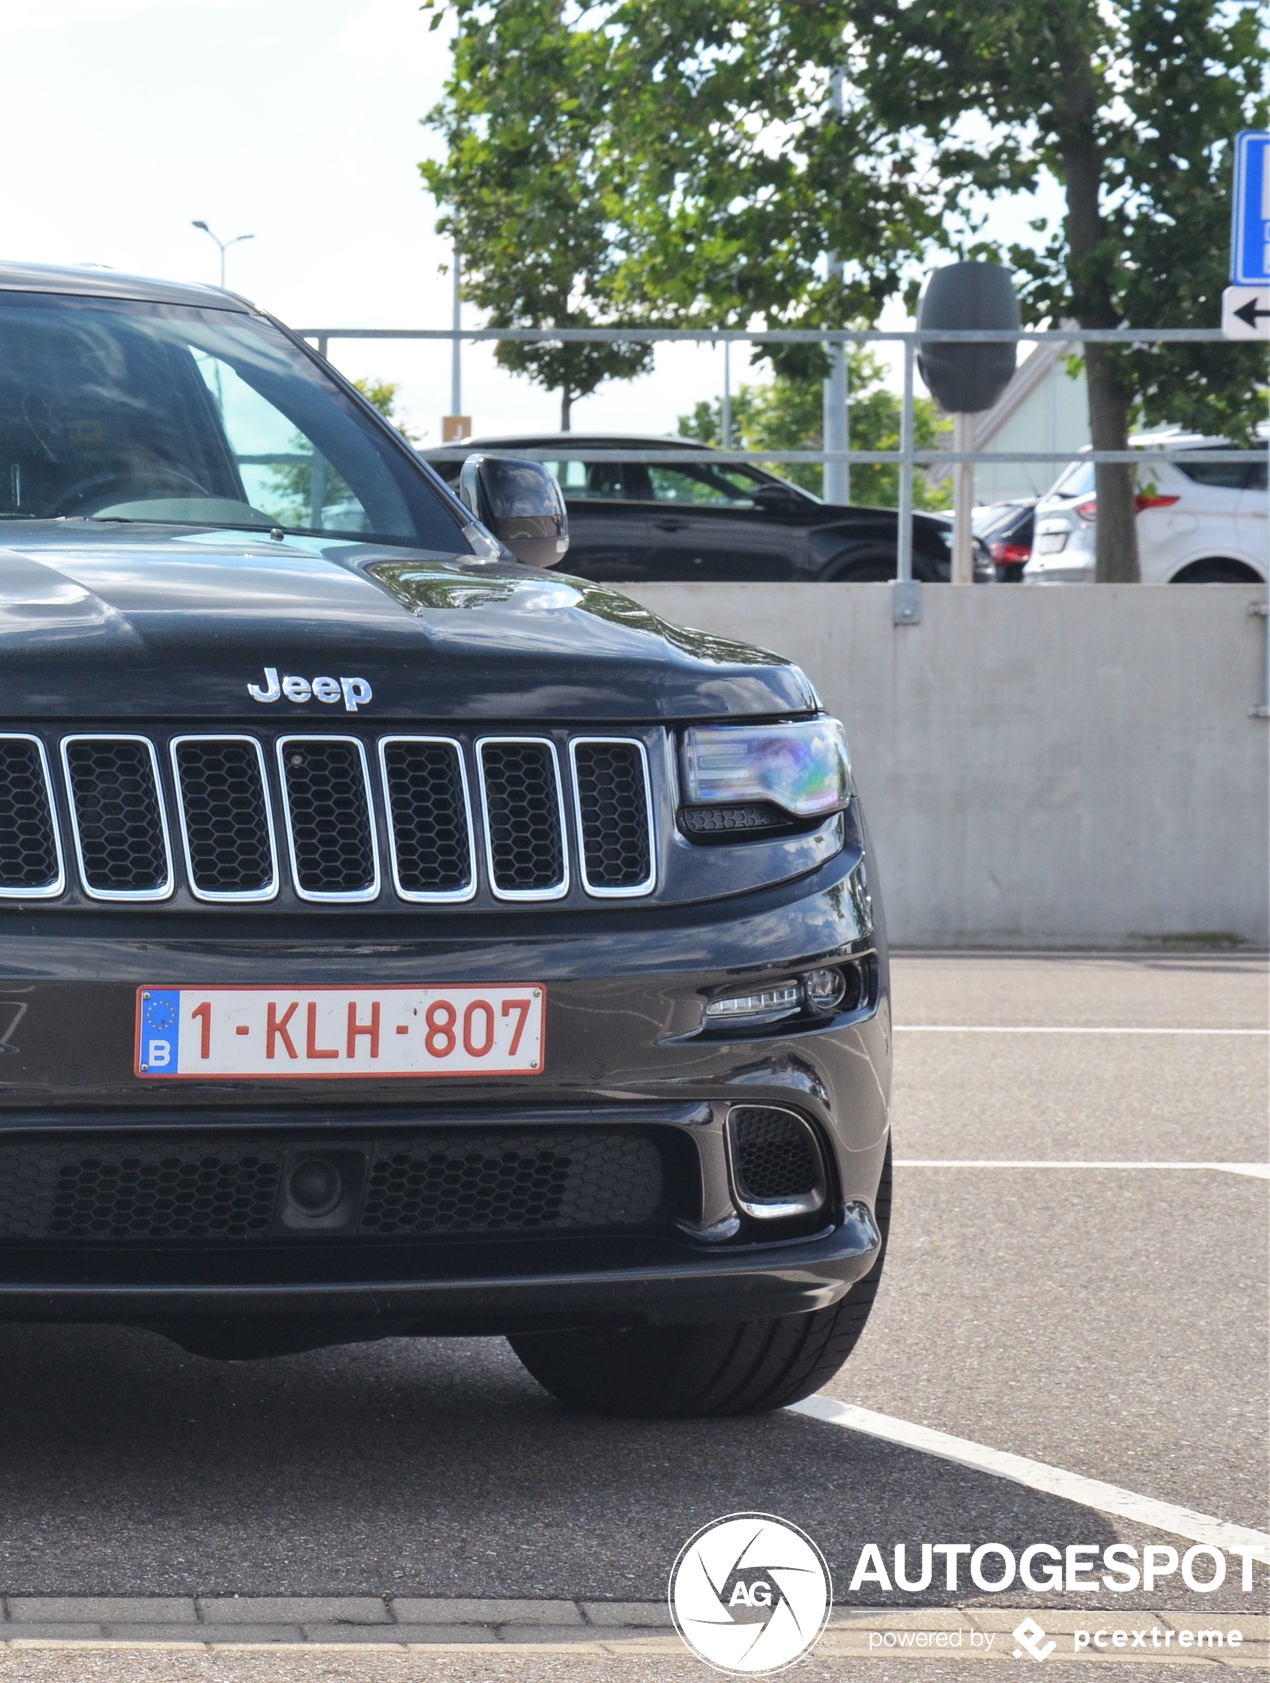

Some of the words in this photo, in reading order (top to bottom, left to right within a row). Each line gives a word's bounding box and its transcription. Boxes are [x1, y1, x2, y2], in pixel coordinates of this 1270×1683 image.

[247, 667, 363, 711] Jeep
[191, 999, 532, 1059] 1-KLH-807
[148, 1040, 171, 1067] B
